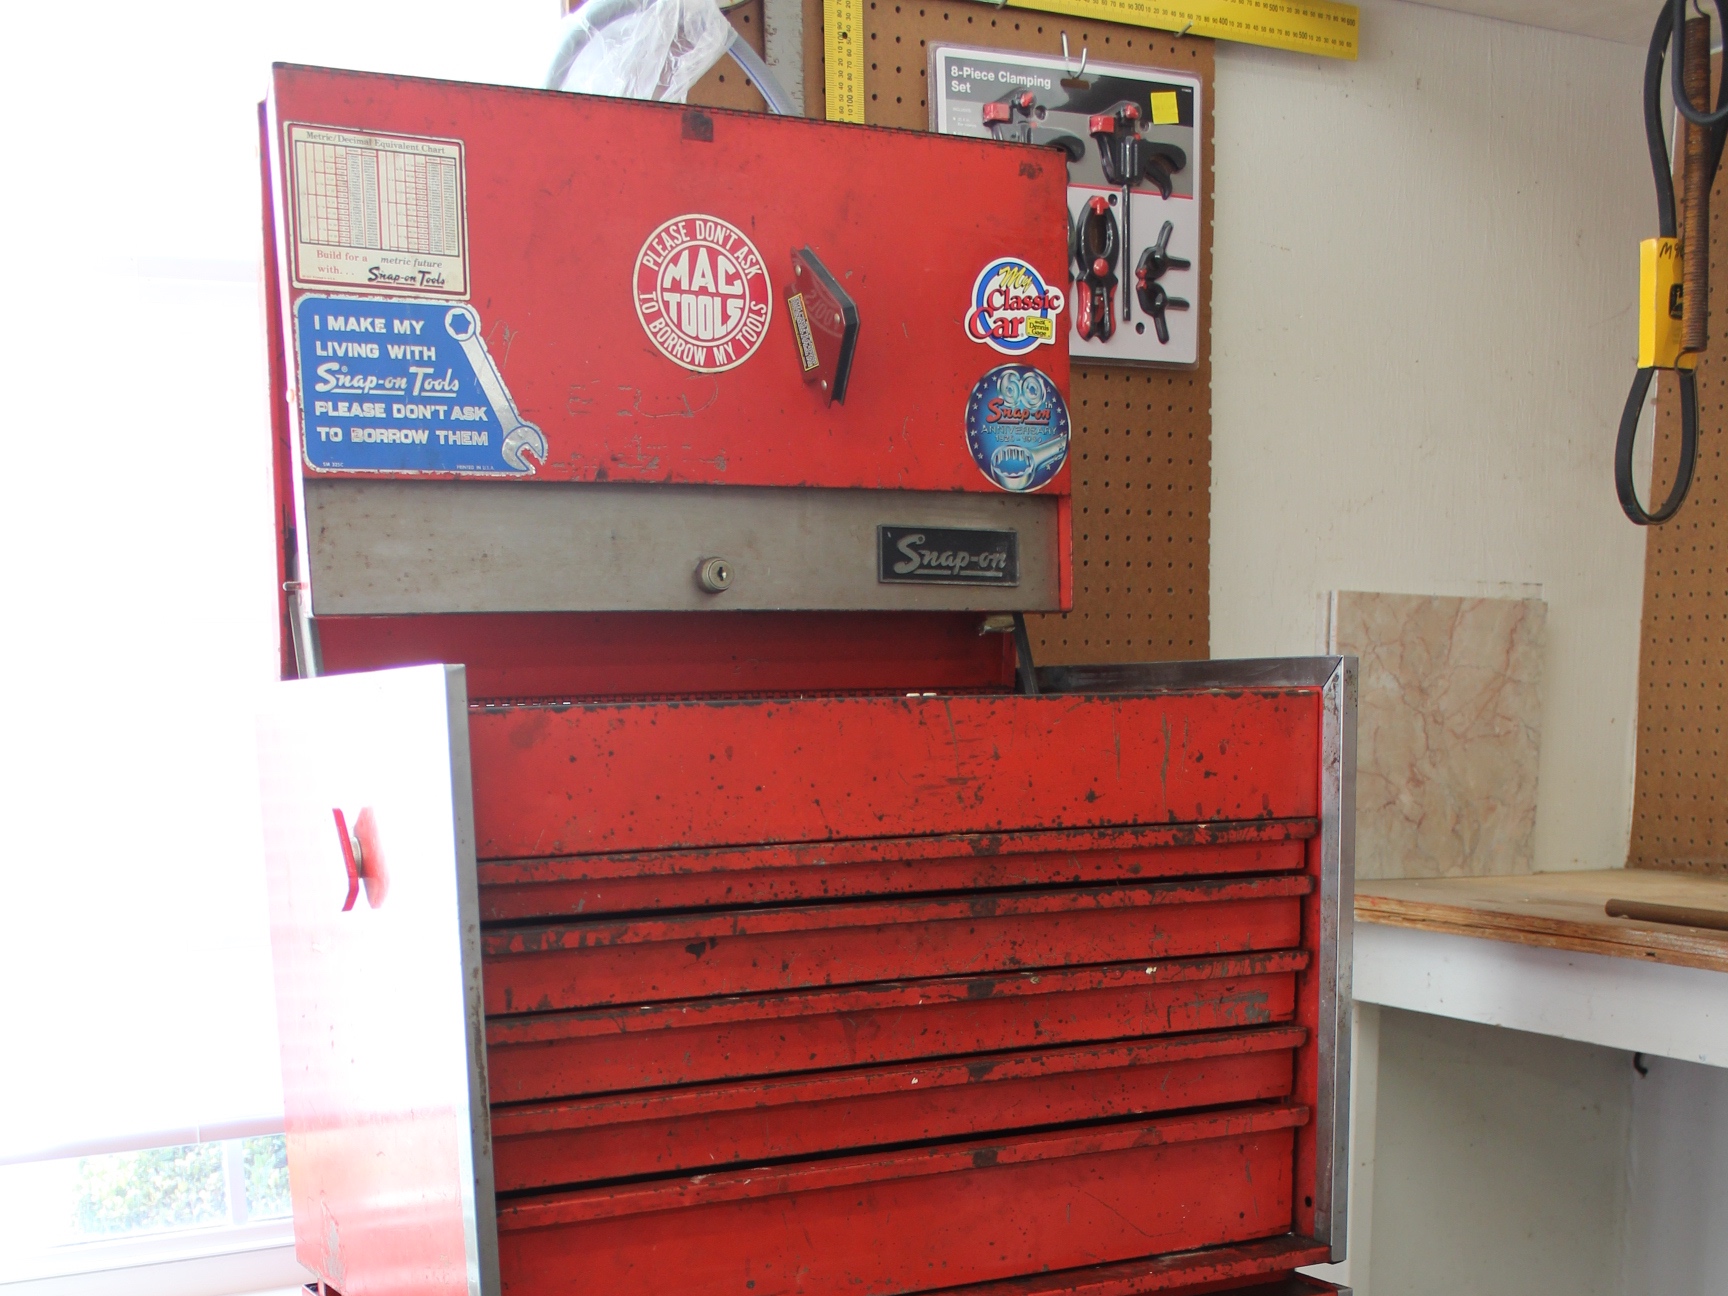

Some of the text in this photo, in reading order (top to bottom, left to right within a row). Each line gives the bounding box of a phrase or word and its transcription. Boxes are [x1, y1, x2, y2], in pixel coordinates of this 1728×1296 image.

[951, 66, 1051, 90] 8-Piece Clamping
[951, 80, 971, 93] Set
[306, 131, 445, 154] Metric/Decimal Equivalent Chart
[316, 249, 342, 260] Build
[345, 250, 359, 261] for
[380, 256, 411, 266] metric
[413, 258, 443, 269] future
[642, 220, 763, 279] PLEASE DON'T ASK
[367, 266, 446, 288] Snap-on Tools
[663, 247, 744, 295] MAC
[998, 266, 1033, 294] My
[986, 287, 1061, 311] Classic
[314, 315, 425, 335] I MAKE MY
[663, 292, 744, 340] TOOLS
[968, 307, 1025, 340] Car
[639, 291, 659, 315] TO
[649, 317, 707, 366] BORROW
[713, 342, 736, 366] MY
[735, 301, 767, 350] TOOLS
[315, 341, 436, 361] LIVING WITH
[409, 366, 460, 398] Tools
[314, 401, 488, 422] PLEASE DON'T ASK
[986, 397, 1051, 424] Snap-on
[316, 427, 489, 446] TO BORROW THEM
[981, 424, 1057, 436] ANNIVERSARY
[893, 534, 1007, 578] Snap-on
